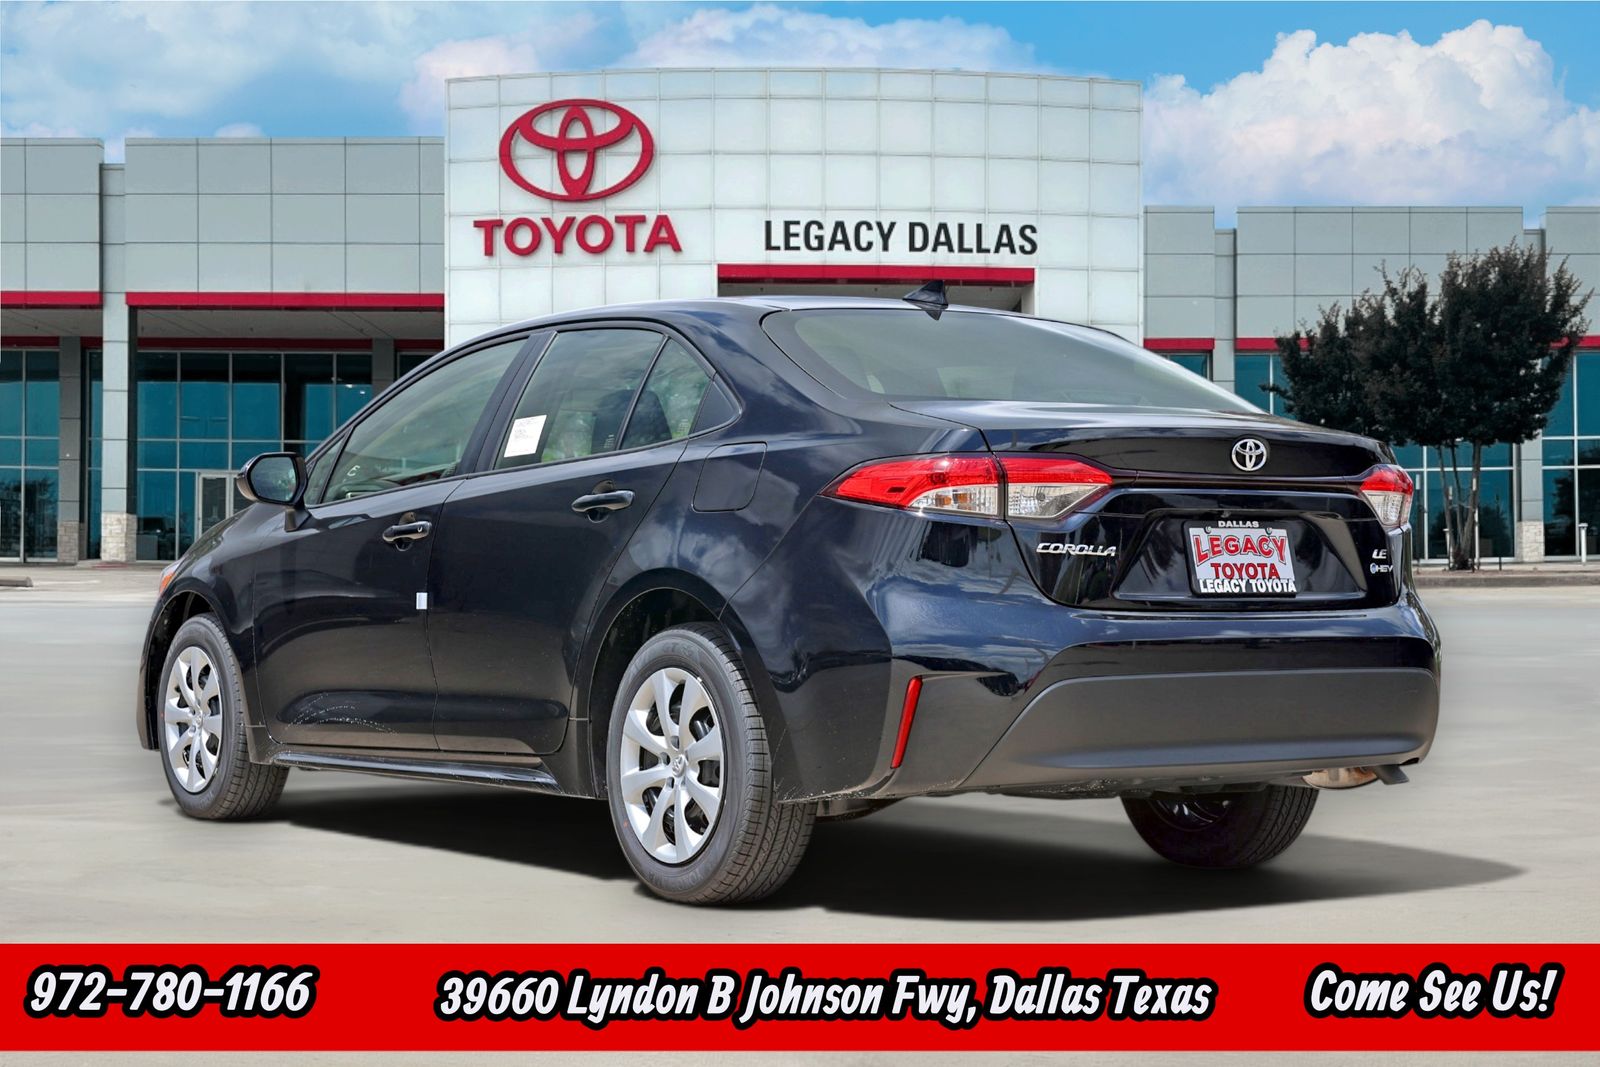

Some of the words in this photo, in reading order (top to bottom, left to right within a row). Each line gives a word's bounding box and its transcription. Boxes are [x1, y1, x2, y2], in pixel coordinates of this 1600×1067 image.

[473, 214, 683, 257] TOYOTA
[765, 220, 897, 252] LEGACY
[908, 221, 1038, 256] DALLAS
[1218, 520, 1259, 528] DALLAS
[1036, 542, 1117, 557] COROLLA
[1193, 535, 1287, 567] LEGACY
[1372, 549, 1388, 559] LE
[1210, 562, 1280, 580] TOYOTA
[1200, 578, 1247, 593] LEGACY
[1248, 580, 1297, 593] TOYOTA
